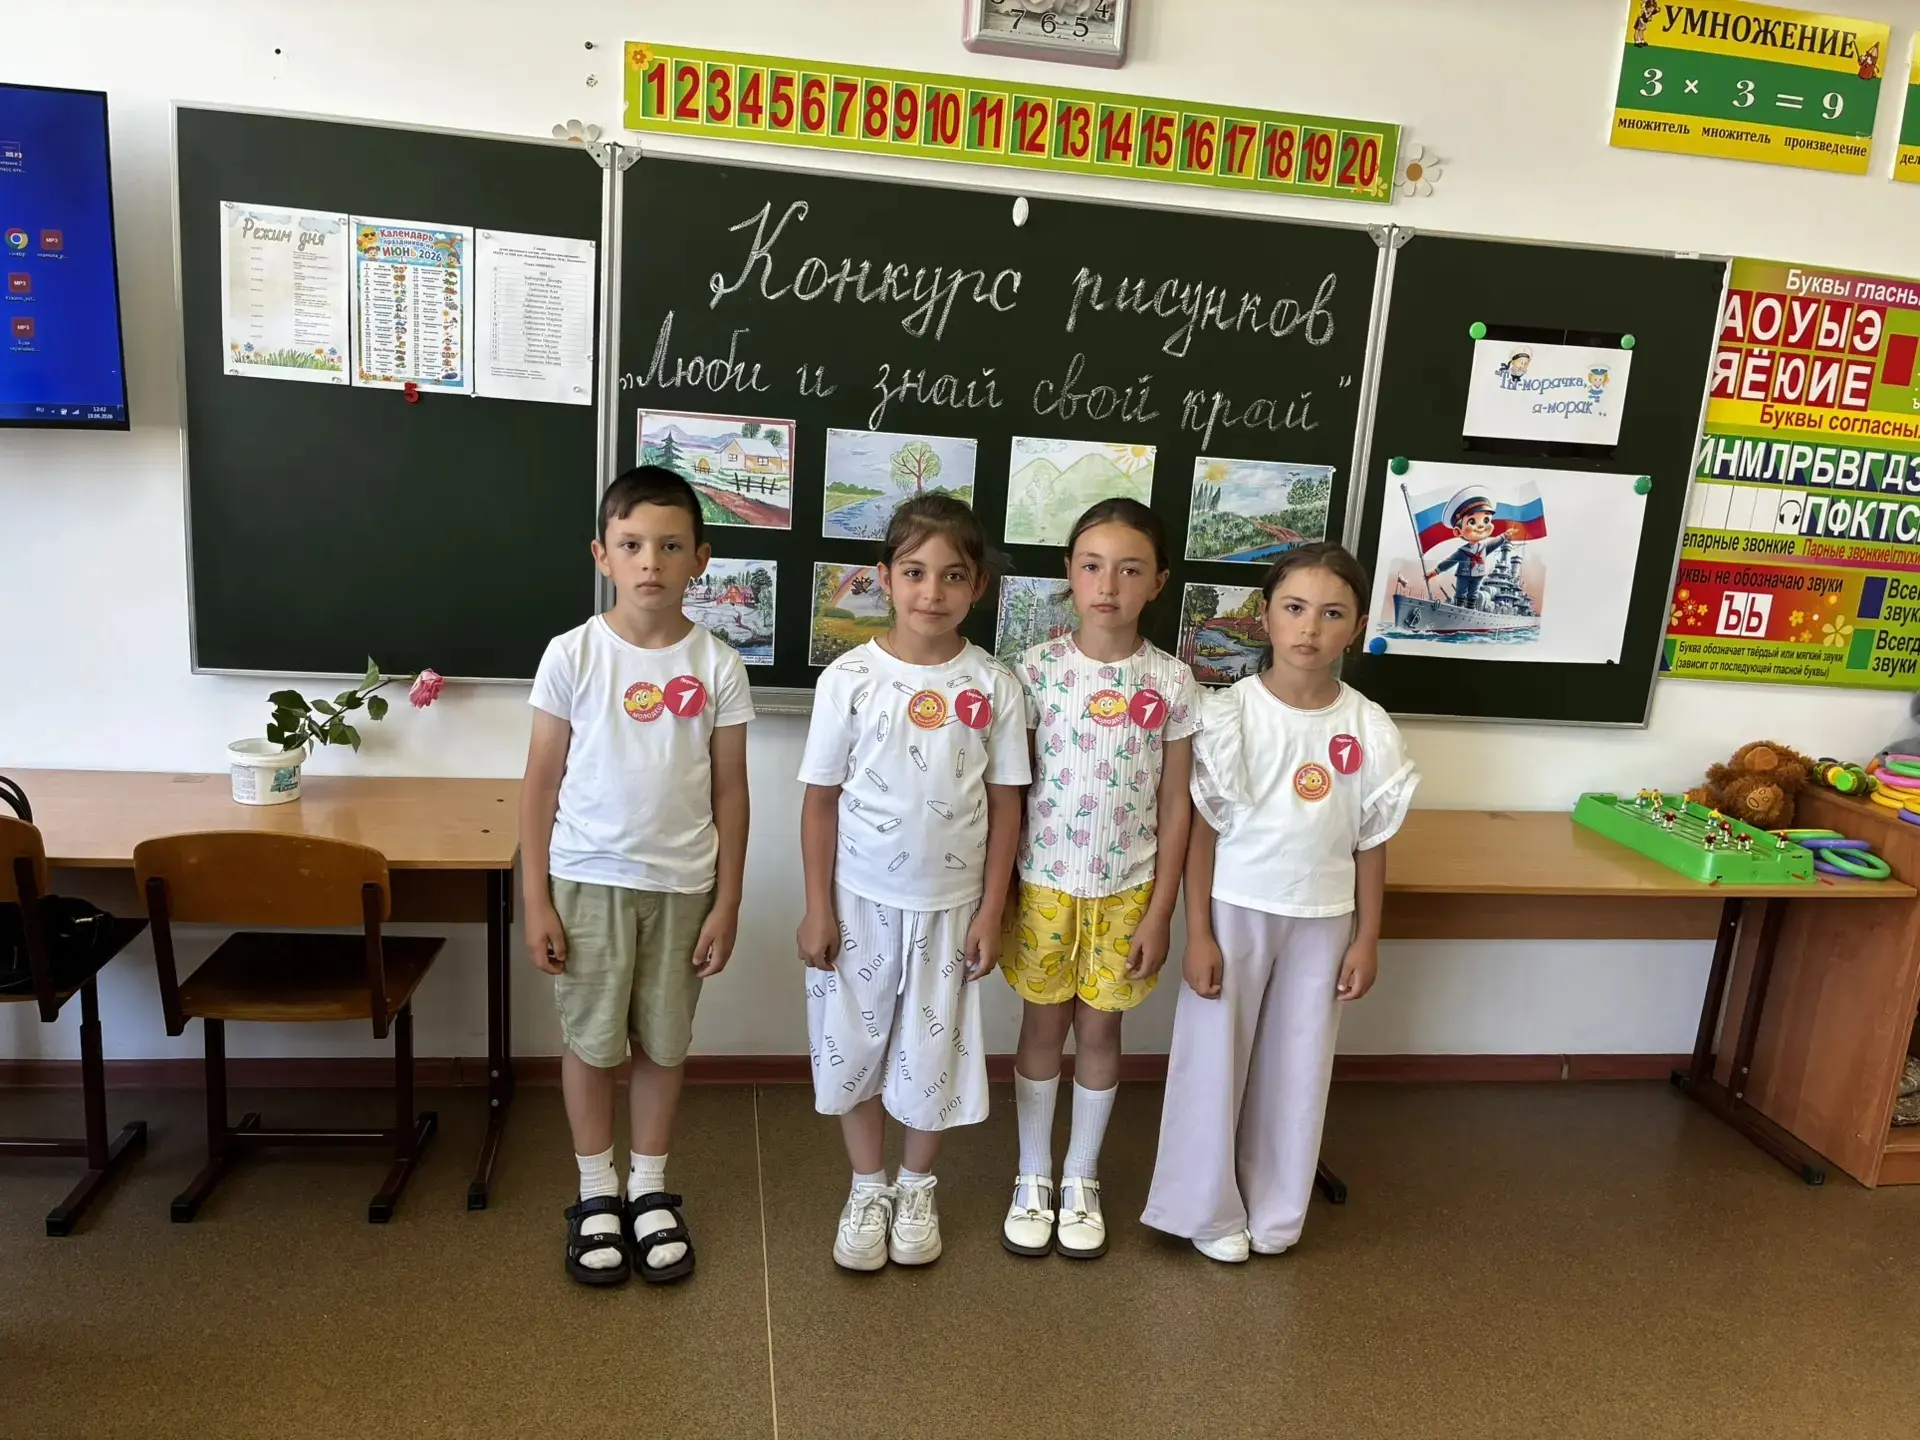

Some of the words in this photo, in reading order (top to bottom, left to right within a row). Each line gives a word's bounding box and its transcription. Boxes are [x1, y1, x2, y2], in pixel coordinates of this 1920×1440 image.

[1010, 8, 1025, 29] 7
[1041, 13, 1057, 34] 6
[1073, 16, 1089, 37] 5
[1094, 0, 1109, 18] 4
[1662, 5, 1857, 59] УМНОЖЕНИЕ
[1639, 68, 1663, 97] 3
[1732, 80, 1755, 108] 3
[1822, 92, 1843, 120] 9
[647, 63, 666, 115] 1
[675, 65, 700, 118] 2
[707, 69, 731, 122] 3
[739, 72, 763, 124] 4
[770, 76, 794, 128] 5
[802, 79, 826, 131] 6
[835, 82, 858, 133] 7
[864, 85, 888, 137] 8
[895, 88, 918, 140] 9
[926, 92, 960, 144] 10
[971, 96, 1004, 148] 11
[1014, 101, 1048, 153] 12
[1056, 105, 1090, 158] 13
[1100, 110, 1132, 162] 14
[1141, 114, 1174, 166] 15
[1182, 120, 1215, 170] 16
[1224, 124, 1256, 174] 17
[1264, 129, 1293, 179] 18
[1301, 132, 1332, 182] 19
[1339, 137, 1378, 187] 20
[1618, 117, 1690, 135] множитель
[1701, 126, 1771, 144] множитель
[1784, 135, 1867, 157] произведение
[242, 217, 292, 243] Режим
[297, 231, 326, 252] дня
[380, 229, 434, 241] Календарь
[382, 246, 416, 257] ИЮНЬ
[419, 250, 442, 261] 2026
[709, 200, 1021, 341] Конкурс
[1065, 266, 1337, 357] рисунков
[1786, 268, 1850, 296] Буквы
[796, 364, 837, 397] и
[868, 363, 1003, 431] знай
[1033, 353, 1159, 420] свой
[1760, 404, 1822, 430] Буквы
[1828, 415, 1920, 439] согласны
[1800, 495, 1920, 542] ПФКТС
[1682, 532, 1740, 554] епарные
[1742, 537, 1795, 555] звонкие
[1802, 538, 1845, 559] Парные
[1676, 568, 1710, 587] уквы
[1714, 570, 1730, 584] не
[1733, 569, 1804, 591] обозначаю
[1807, 576, 1843, 597] звуки
[1884, 605, 1920, 627] звук
[1679, 641, 1701, 654] Буква
[1703, 643, 1745, 656] обозначает
[1747, 646, 1779, 659] твёрдый
[1780, 649, 1794, 659] или
[1796, 649, 1822, 662] мягкий
[1823, 652, 1843, 664] звуки
[1872, 656, 1917, 678] звуки
[1675, 658, 1708, 670] (зависит
[1710, 661, 1718, 670] от
[1719, 662, 1772, 676] последующей
[1773, 664, 1802, 675] гласной
[1804, 665, 1830, 679] буквы)
[838, 920, 858, 952] Dior
[858, 953, 885, 982] Dior
[941, 948, 965, 978] Dior
[827, 974, 836, 993] ior
[862, 1011, 880, 1038] Dior
[922, 1005, 944, 1037] Dior
[825, 1034, 844, 1067] Dior
[842, 1065, 869, 1092] Dior
[900, 1050, 912, 1082] Dior
[924, 1071, 948, 1098] Dior
[939, 1096, 962, 1122] Dior
